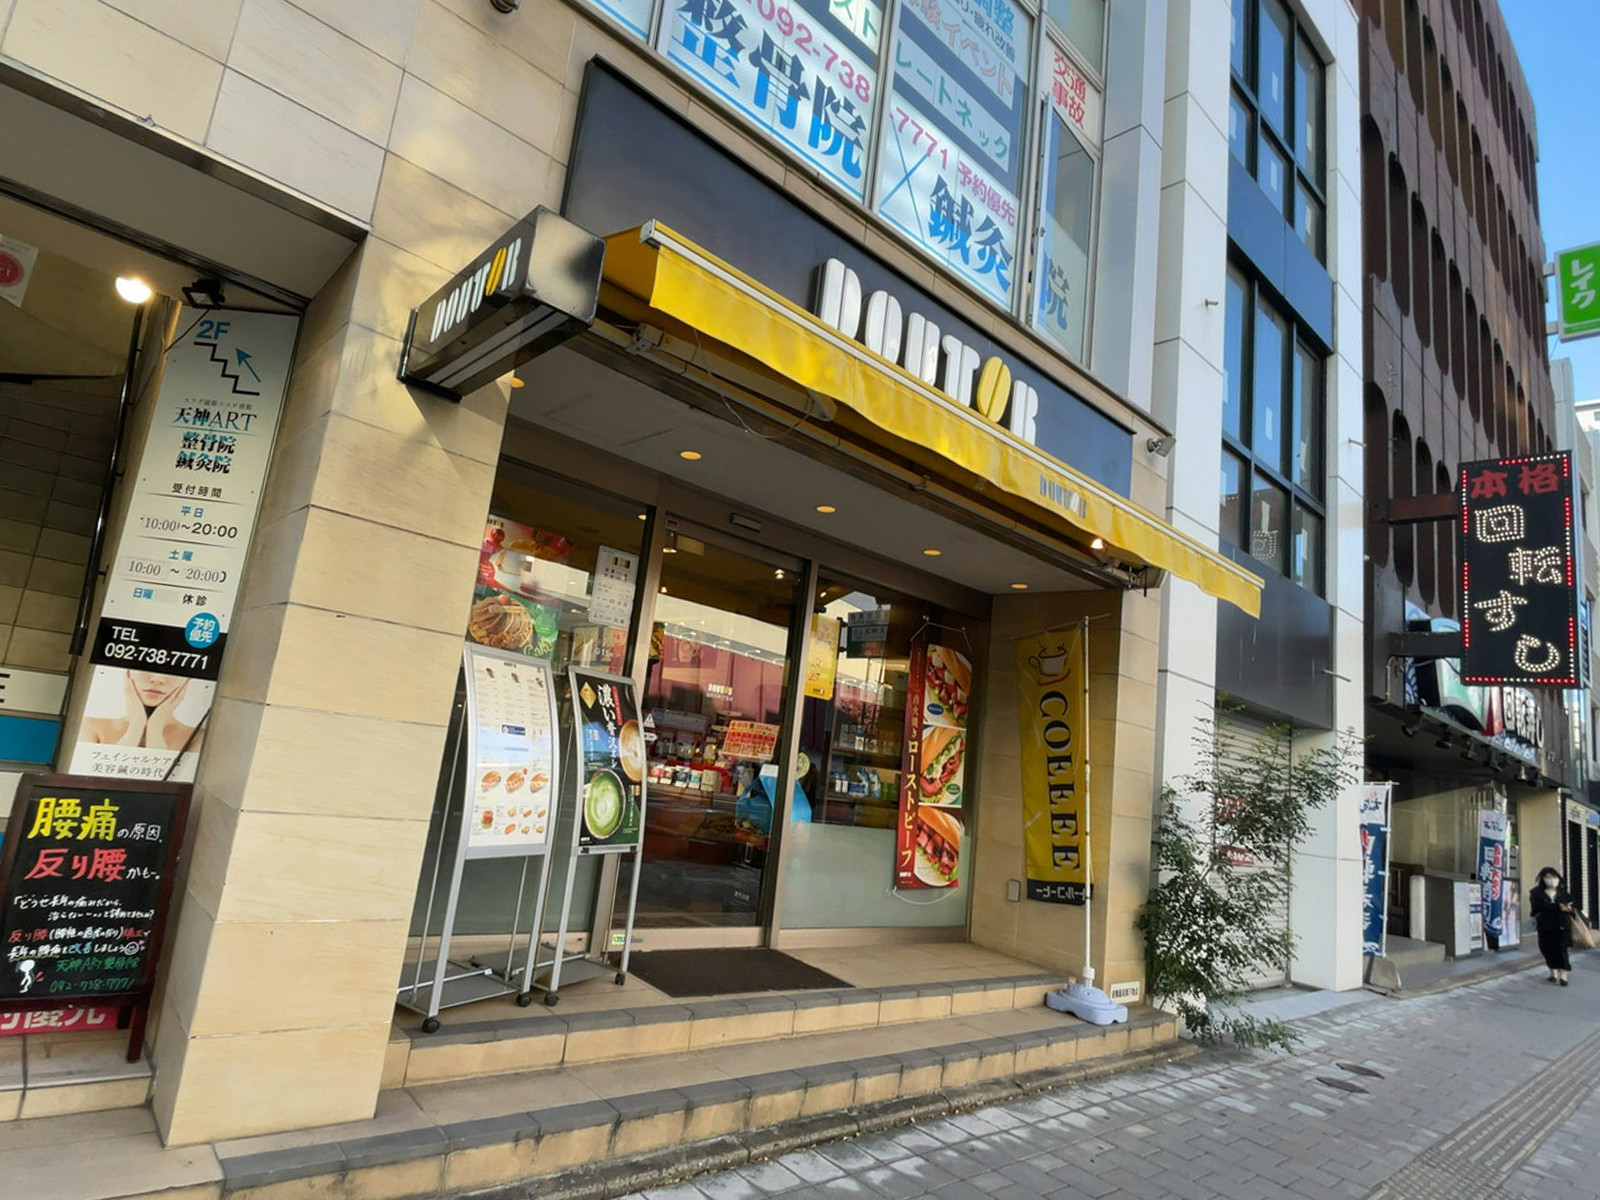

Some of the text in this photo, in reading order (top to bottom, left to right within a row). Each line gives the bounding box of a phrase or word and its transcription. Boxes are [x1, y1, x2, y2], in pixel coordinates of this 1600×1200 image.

[1053, 51, 1086, 105] 交通
[1052, 76, 1085, 129] 事故
[958, 161, 1015, 227] 予約優先
[1570, 259, 1596, 309] レイク
[196, 320, 231, 340] 2F
[818, 257, 1039, 447] DOUTOR
[172, 407, 257, 431] 天神ART
[180, 431, 237, 454] 整骨院
[175, 450, 232, 474] 鍼灸院
[172, 483, 222, 498] 受付時間
[1471, 463, 1560, 500] 本格
[181, 505, 204, 518] 平日
[169, 550, 193, 561] 土曜
[133, 587, 207, 606] 日曜 休診
[112, 626, 139, 642] TEL
[190, 629, 213, 643] 優先
[192, 617, 215, 632] 予約
